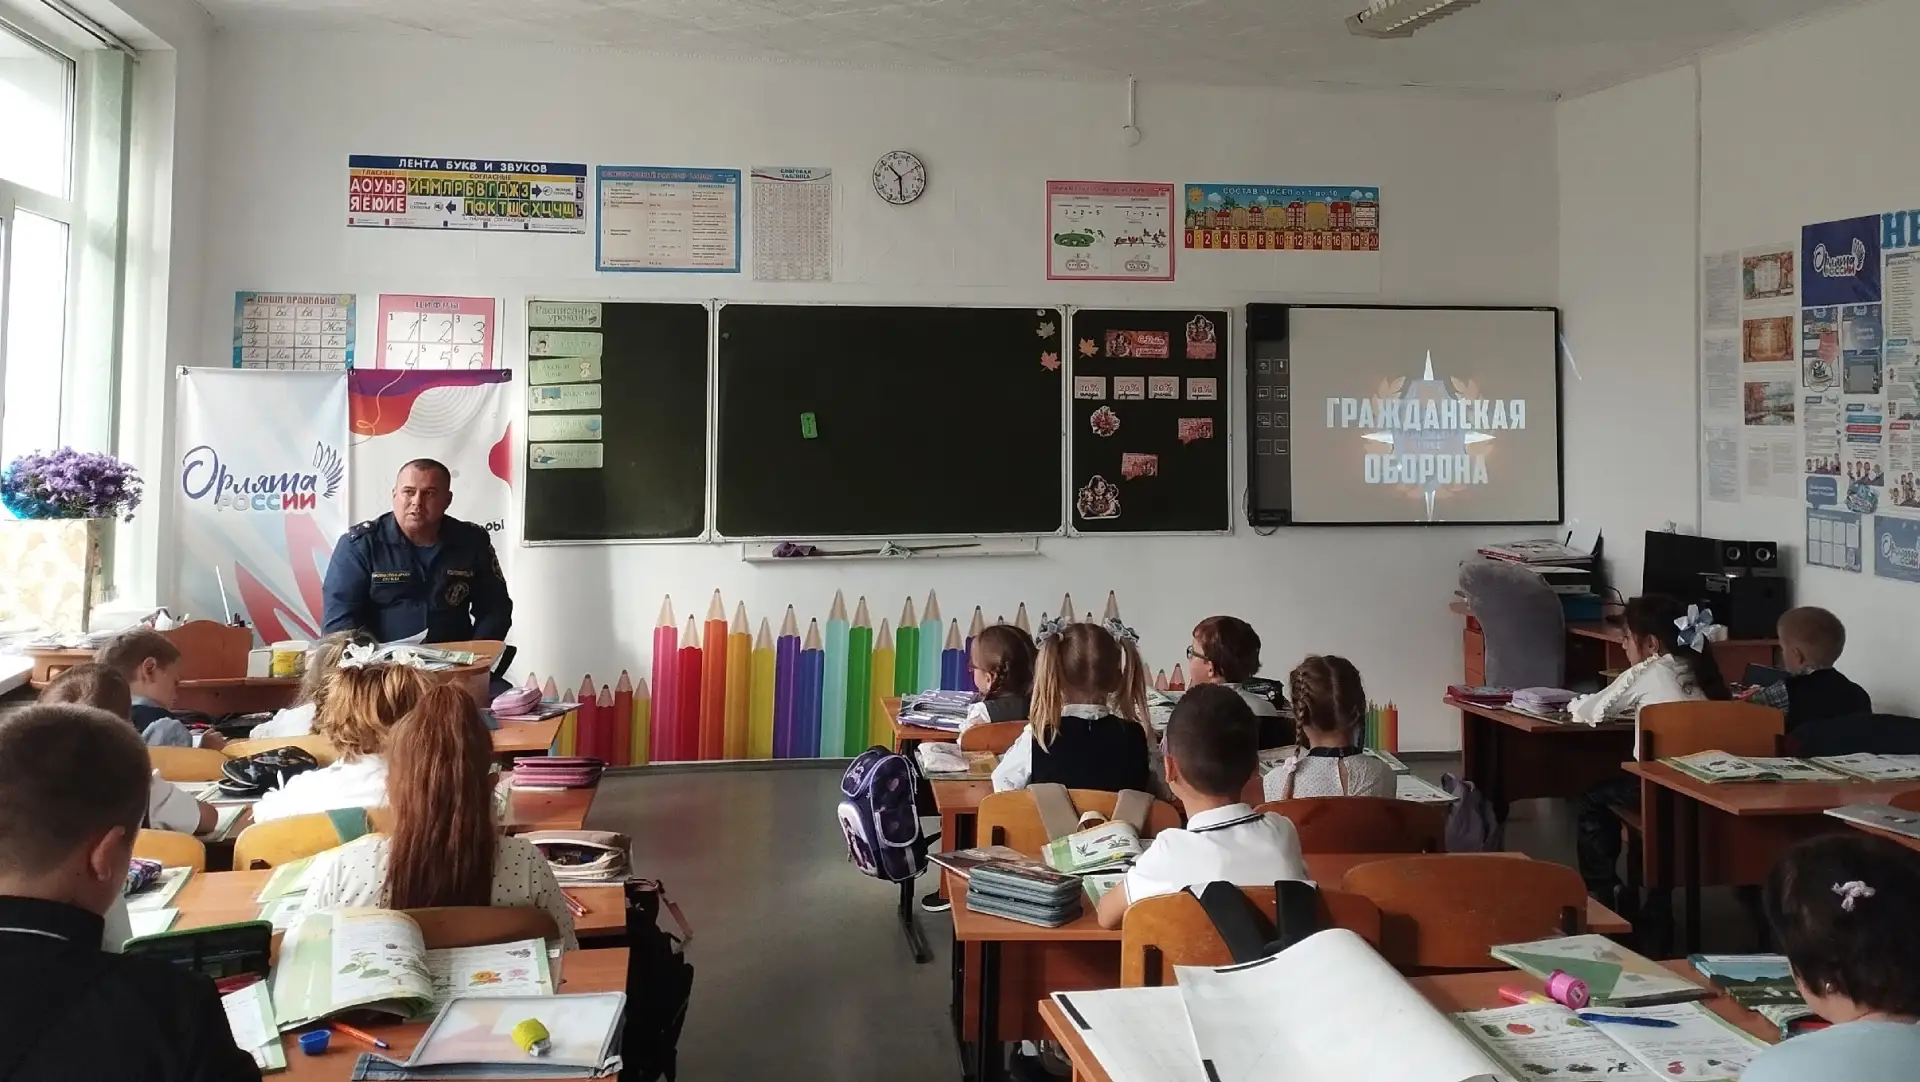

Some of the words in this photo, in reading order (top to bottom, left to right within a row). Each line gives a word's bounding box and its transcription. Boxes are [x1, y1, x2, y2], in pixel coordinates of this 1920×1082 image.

[398, 158, 439, 169] ЛЕНТА
[446, 160, 477, 171] БУКВ
[484, 162, 493, 171] И
[500, 162, 548, 173] ЗВУКОВ
[469, 173, 512, 181] СОГЛАСНЫЕ
[1223, 187, 1258, 195] СОСТАВ
[1263, 188, 1293, 196] ЧИСЕЛ
[1187, 233, 1192, 244] 0
[1205, 233, 1211, 244] 2
[1223, 233, 1228, 244] 4
[1232, 233, 1238, 244] 5
[1241, 233, 1247, 244] 6
[1259, 233, 1264, 244] 8
[1276, 235, 1284, 246] 10
[1294, 235, 1303, 246] 12
[1313, 235, 1322, 246] 14
[1332, 235, 1341, 246] 16
[1369, 235, 1378, 246] 20
[257, 295, 283, 304] ПИШИ
[286, 296, 336, 305] ПРАВИЛЬНО
[415, 301, 460, 309] ЦИФРЫ
[535, 305, 597, 315] Расписание
[389, 313, 394, 321] 1
[422, 314, 428, 322] 2
[456, 315, 461, 323] 3
[547, 314, 584, 324] уроков
[407, 320, 420, 341] 1
[438, 320, 453, 343] 2
[471, 321, 485, 344] 3
[421, 345, 427, 353] 5
[1119, 383, 1140, 392] 20%
[1152, 382, 1174, 391] 30%
[1326, 397, 1526, 431] ГРАЖДАНСКАЯ
[1364, 453, 1489, 484] ОБОРОНА
[182, 445, 317, 505] Орлята
[216, 492, 316, 512] РОССИИ
